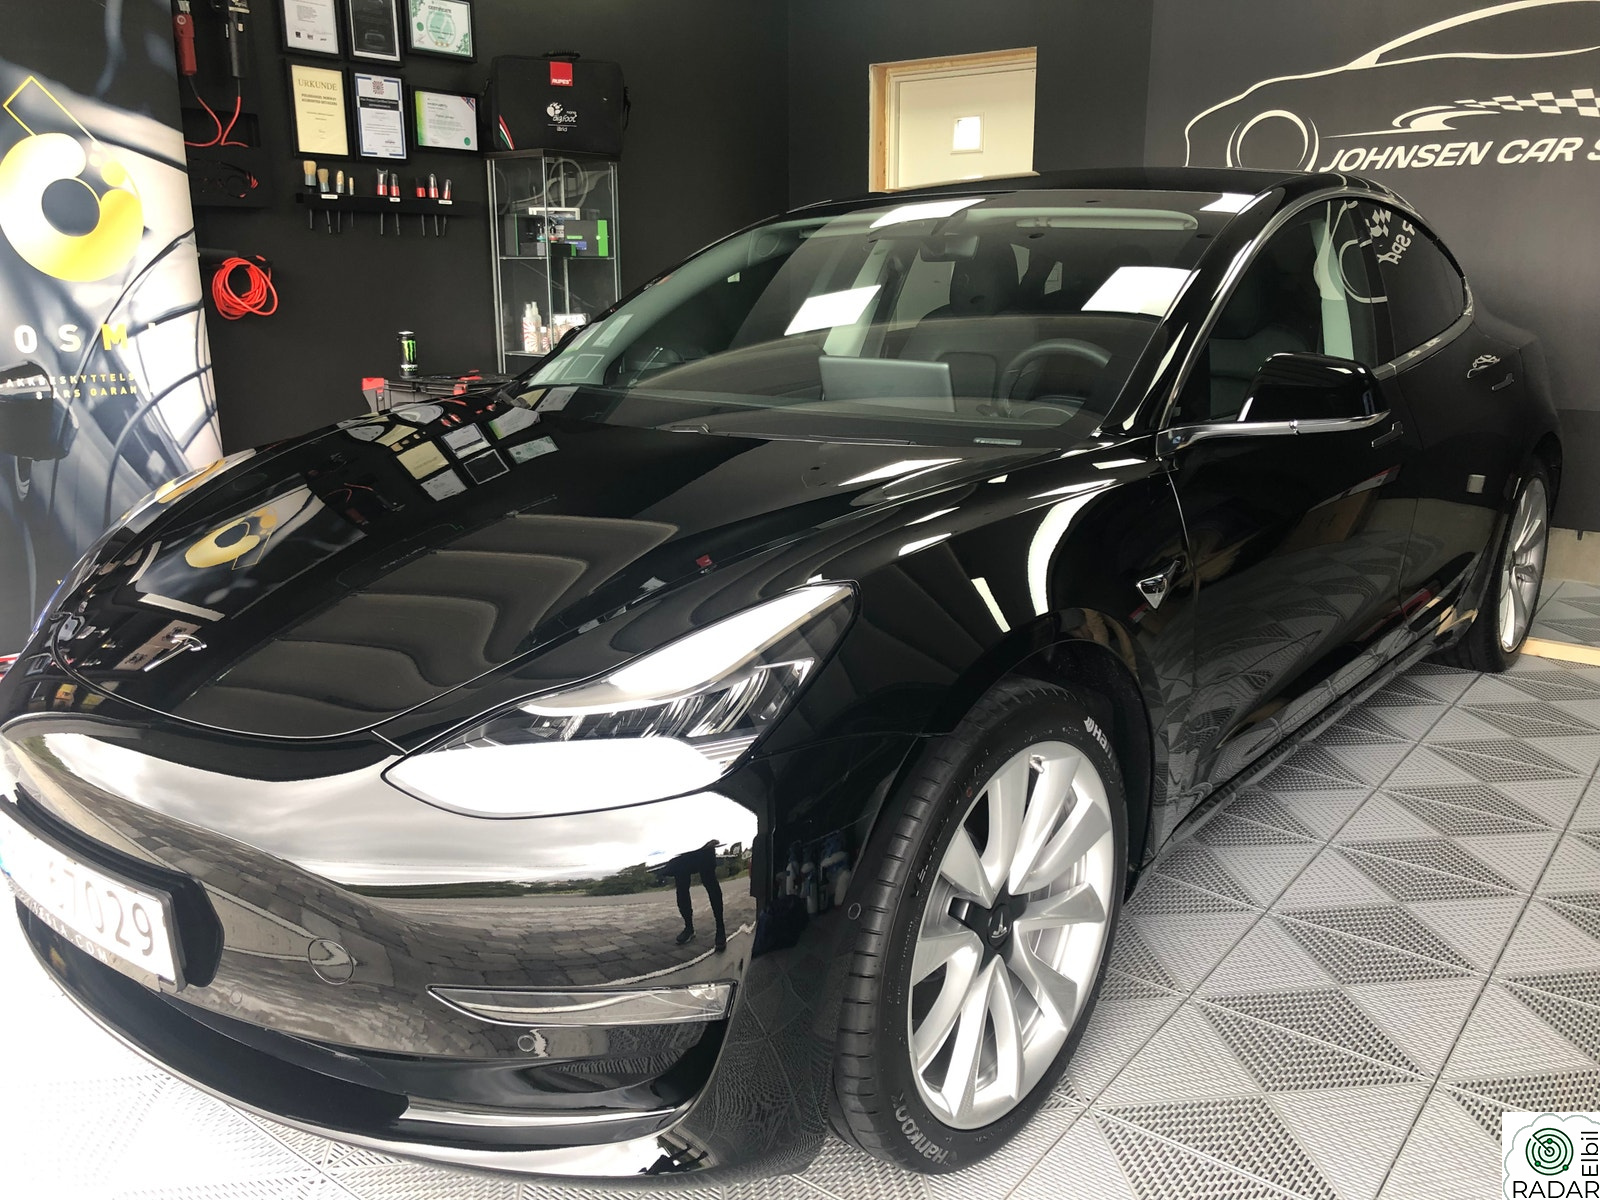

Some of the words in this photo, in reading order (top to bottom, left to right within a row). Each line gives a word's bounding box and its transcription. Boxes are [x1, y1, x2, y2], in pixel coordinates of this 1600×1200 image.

[297, 78, 338, 91] URKUNDE
[1319, 141, 1494, 172] JOHNSEN
[1497, 137, 1584, 164] CAR
[0, 372, 135, 388] AKKBESKYTTELS
